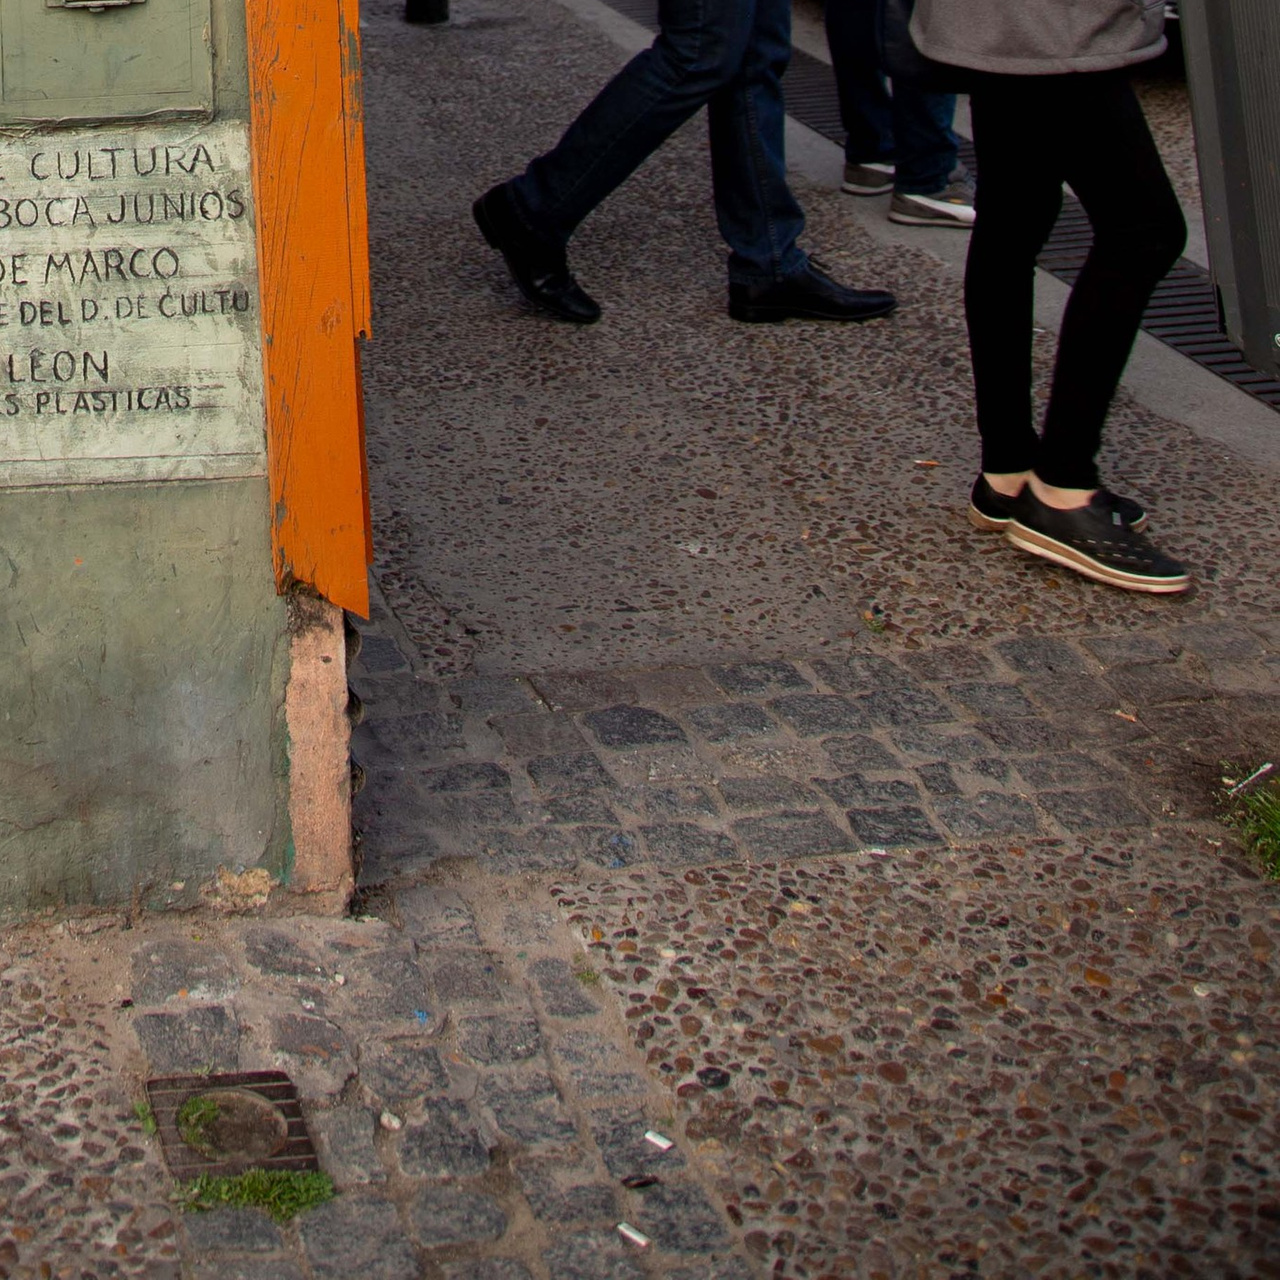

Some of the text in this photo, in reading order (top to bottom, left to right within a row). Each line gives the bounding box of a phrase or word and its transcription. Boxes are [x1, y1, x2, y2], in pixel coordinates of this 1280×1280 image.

[30, 144, 216, 181] CULTURA
[106, 190, 245, 225] JUNIOS
[44, 247, 180, 286] MARCO
[19, 300, 72, 327] DEL
[115, 295, 153, 320] DE
[35, 387, 191, 415] PLASTICAS
